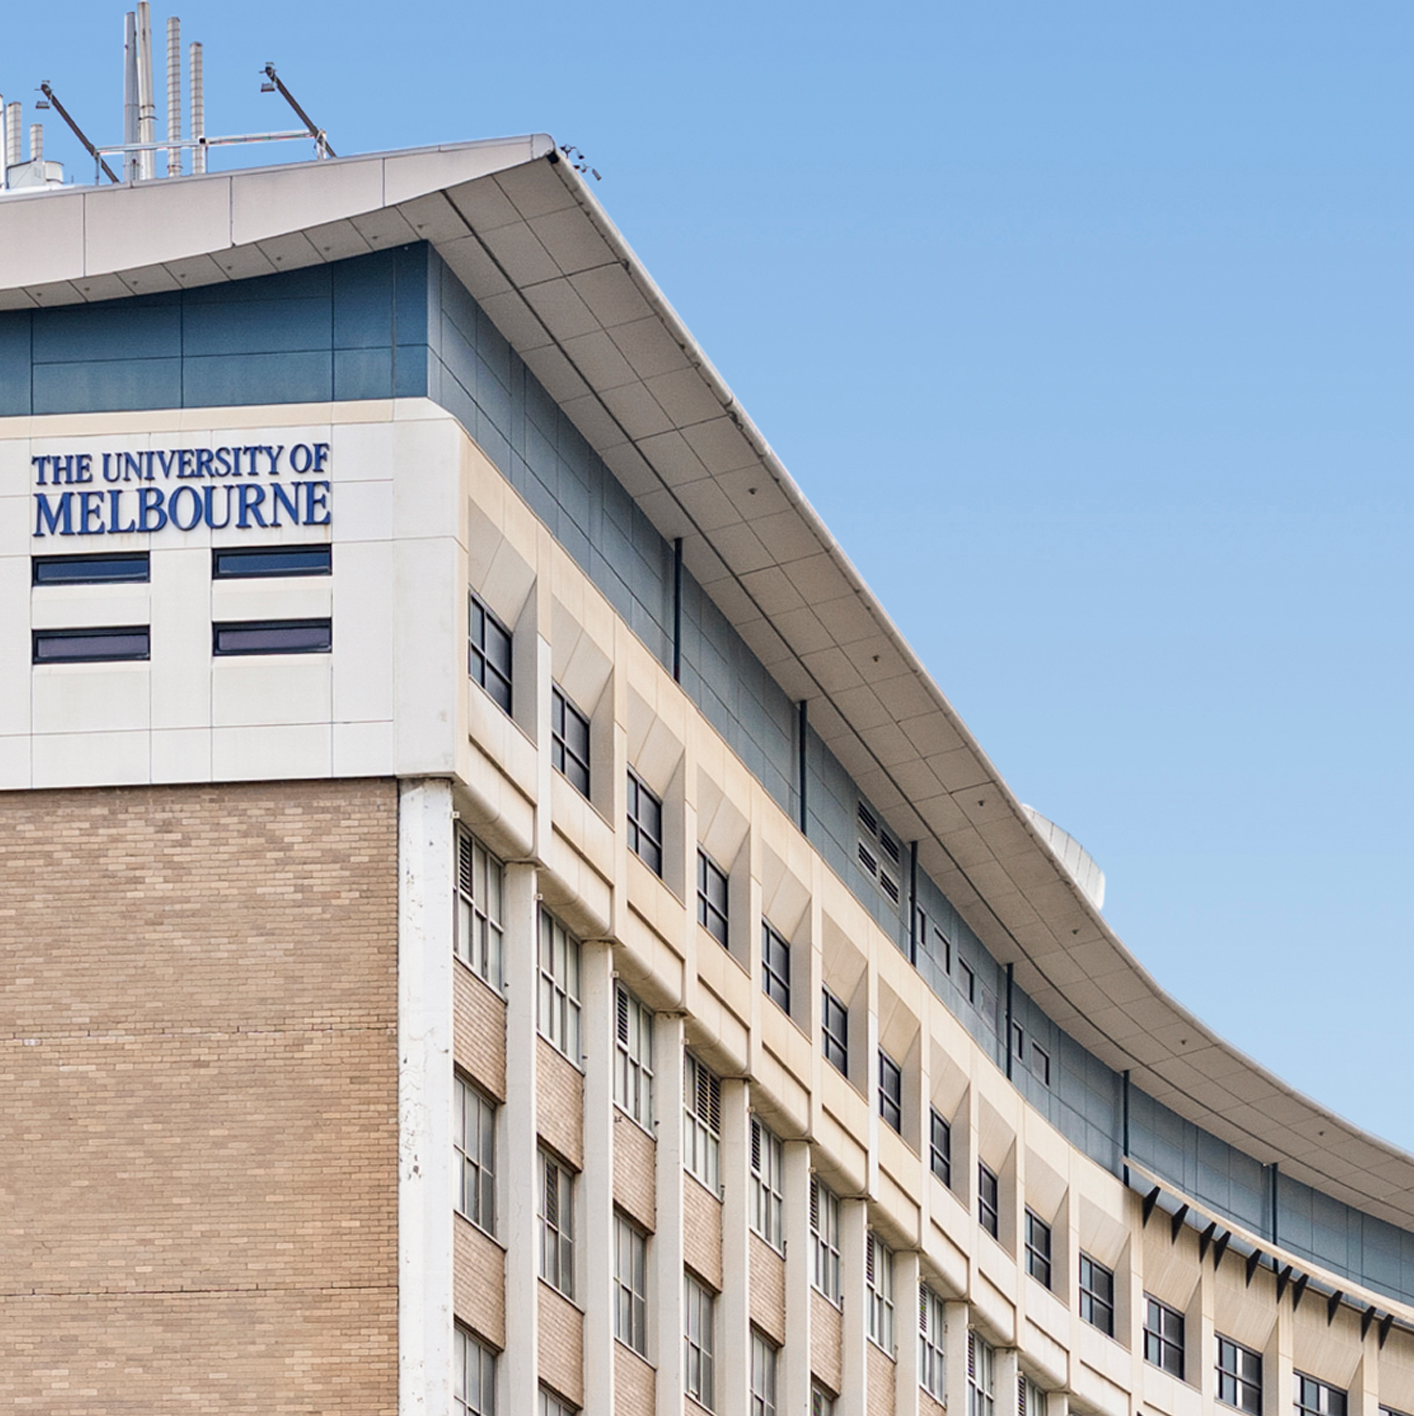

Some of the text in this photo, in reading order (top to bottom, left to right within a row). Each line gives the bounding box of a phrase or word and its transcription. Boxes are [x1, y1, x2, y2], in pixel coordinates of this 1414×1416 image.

[32, 443, 330, 485] THE UNIVERSITY OF
[33, 481, 331, 537] MELBOURNE
